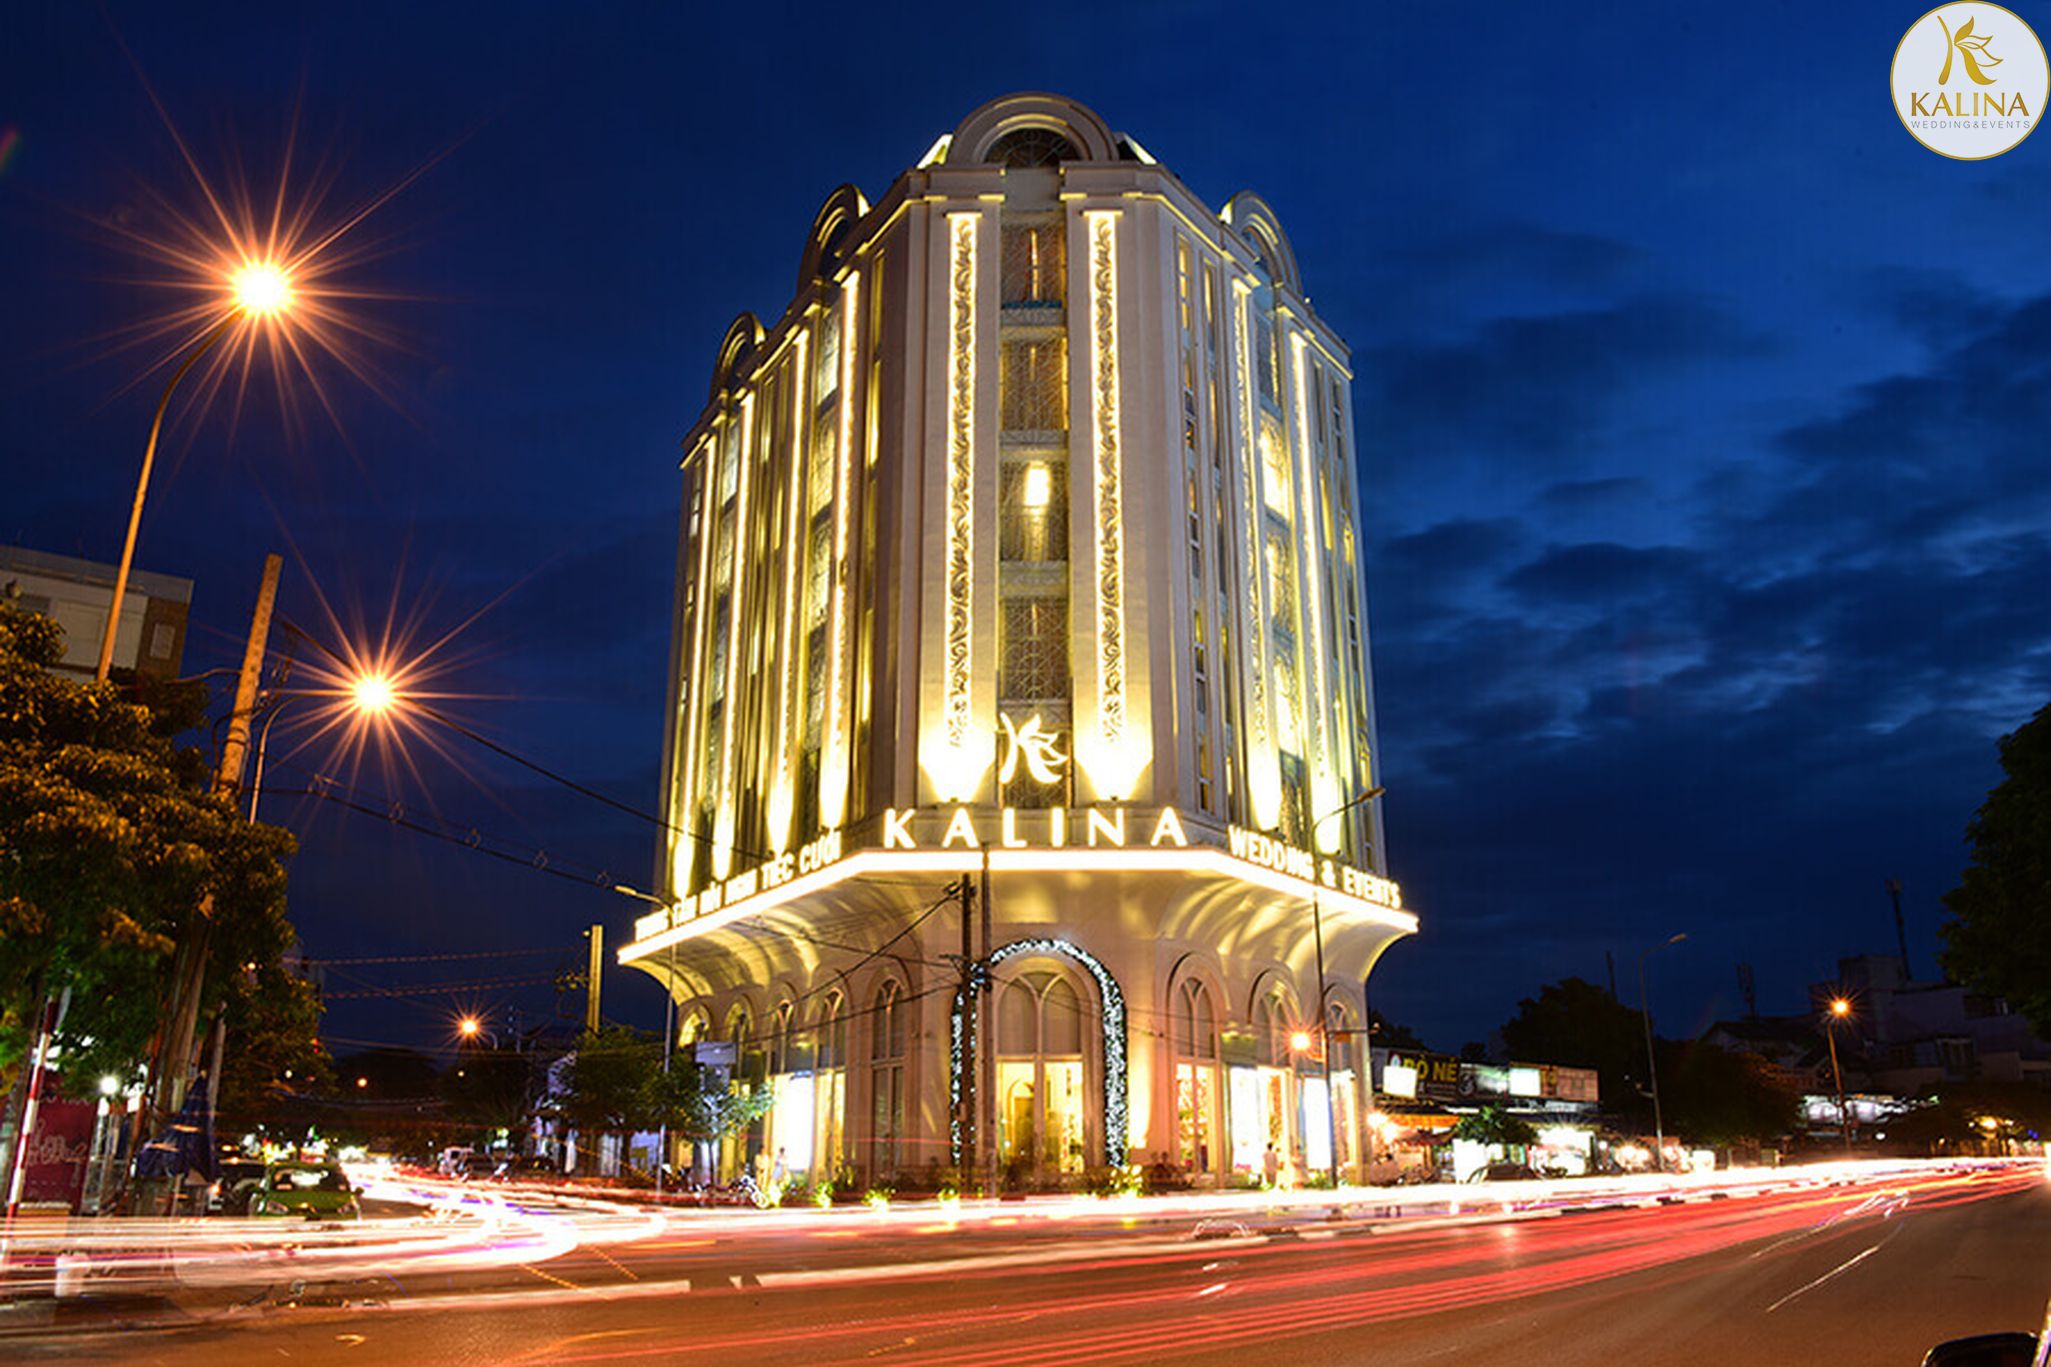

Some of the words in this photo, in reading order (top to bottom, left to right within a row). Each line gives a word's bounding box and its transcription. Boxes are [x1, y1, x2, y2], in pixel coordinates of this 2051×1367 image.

[883, 806, 1187, 849] KALINA
[1228, 824, 1315, 881] WEDDING
[1320, 859, 1336, 888] &
[1341, 865, 1402, 909] EVENTS
